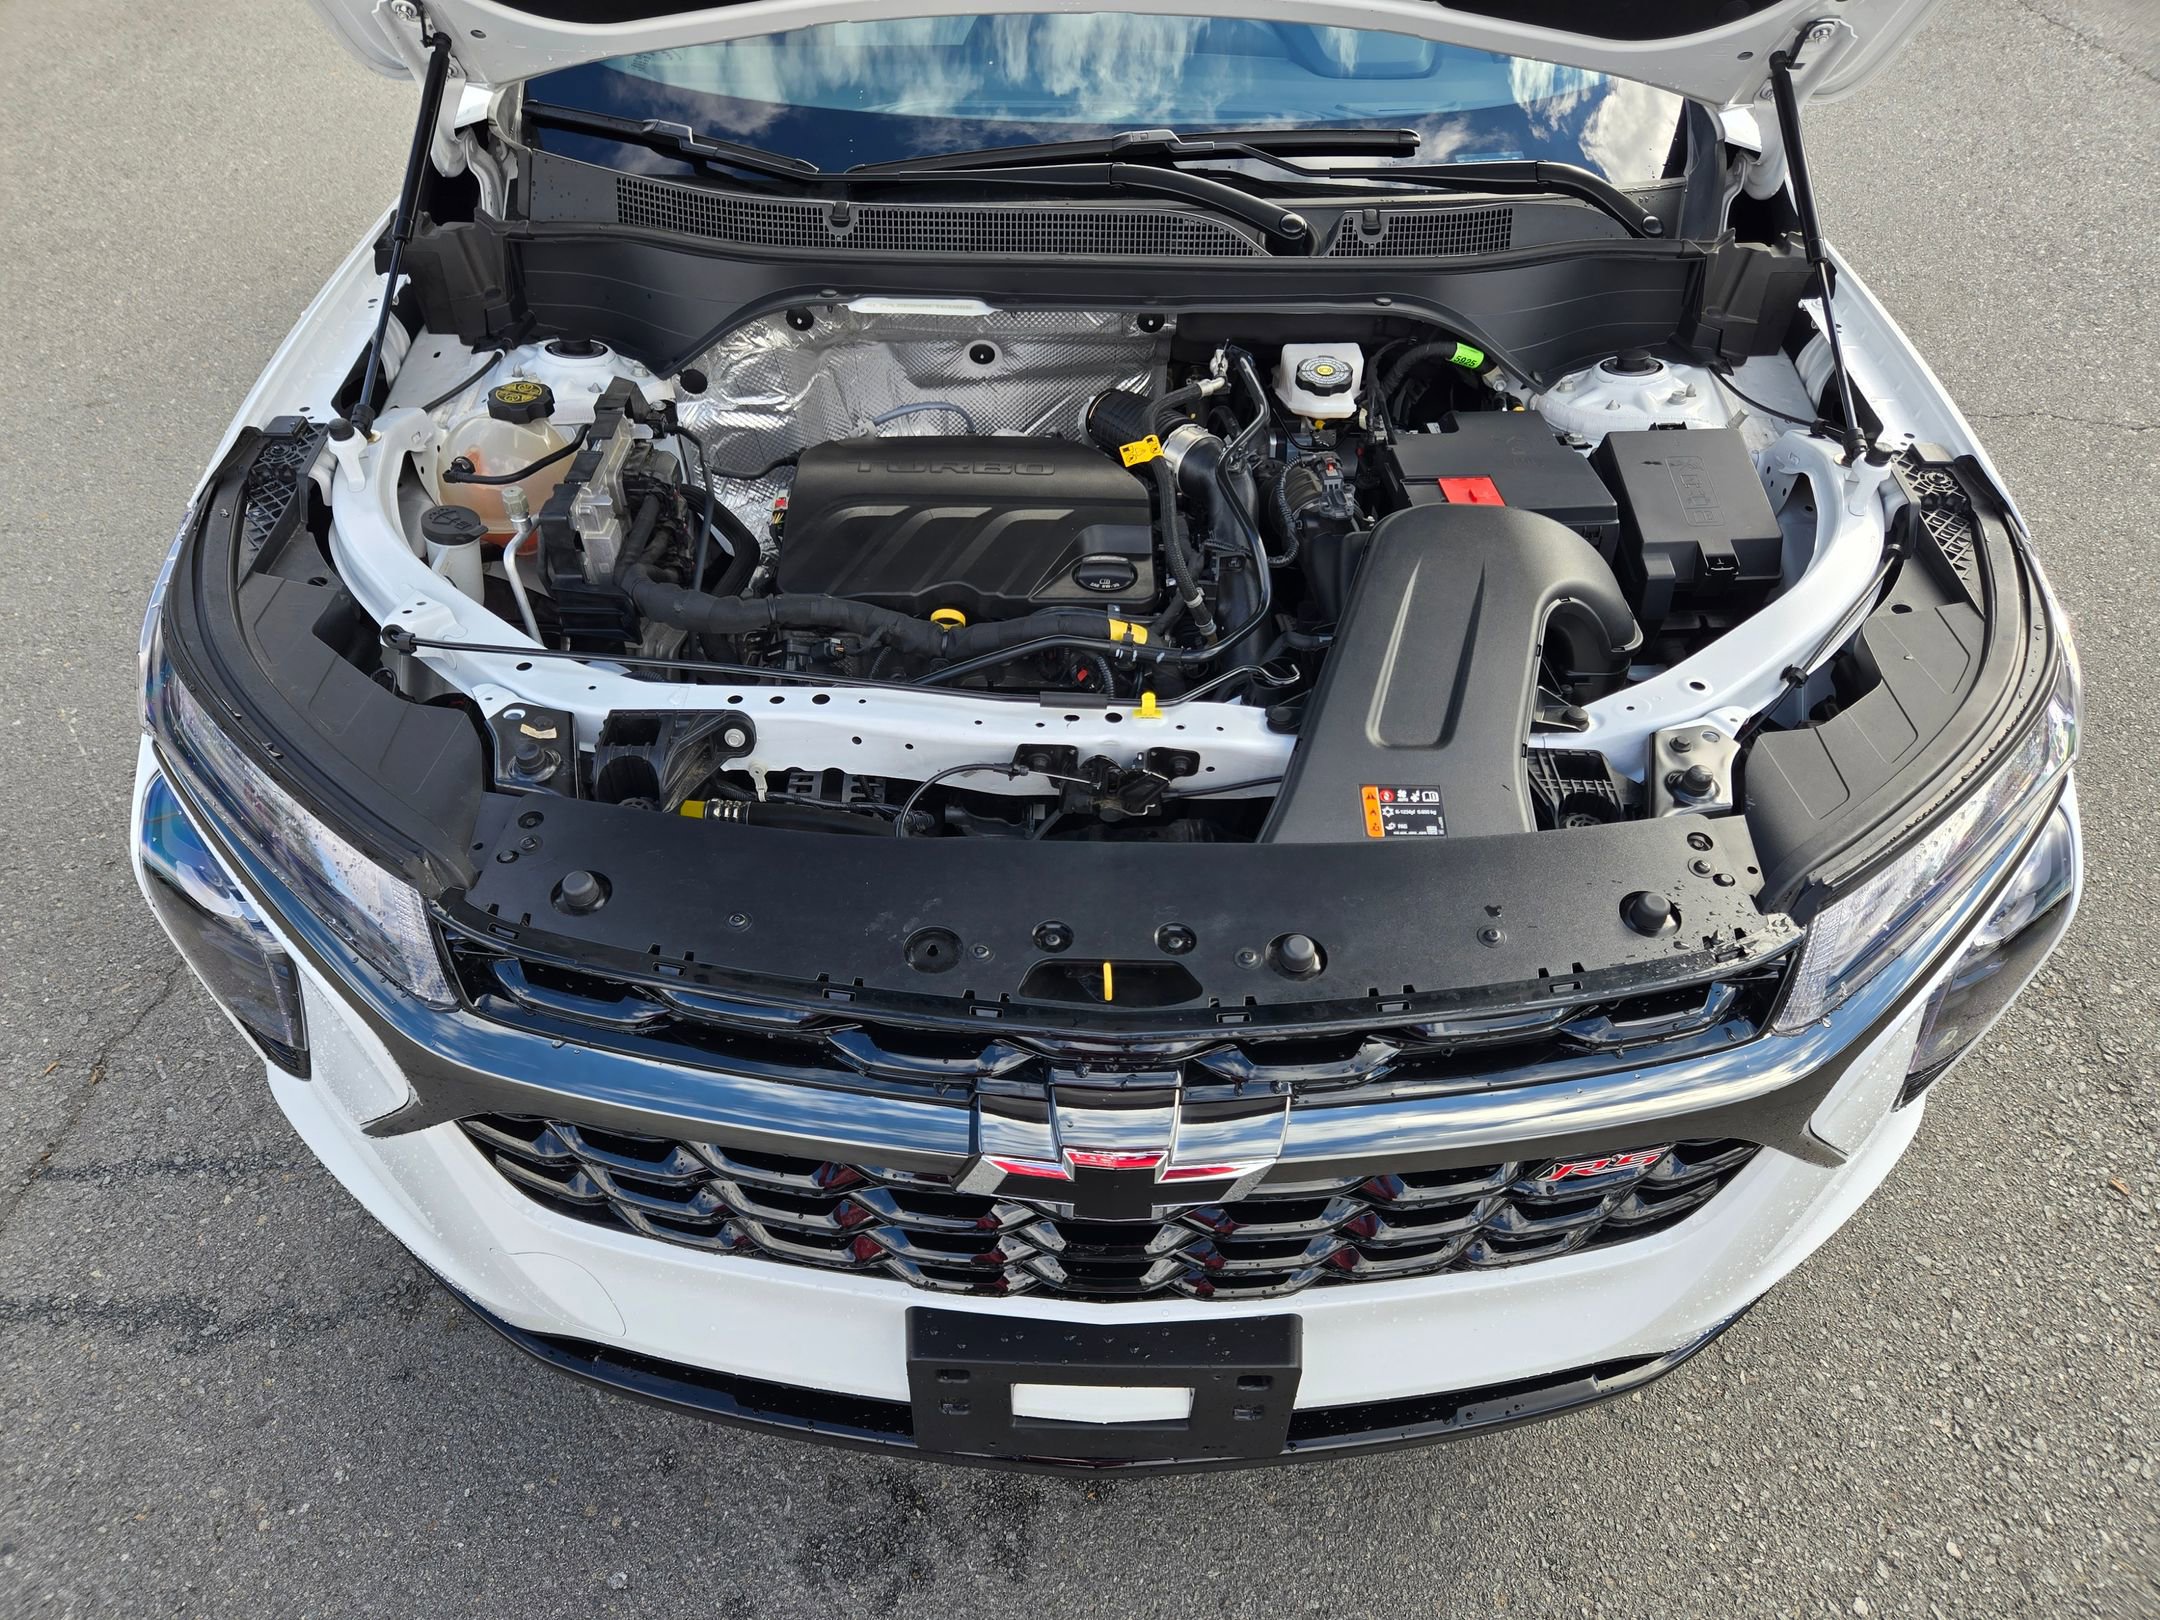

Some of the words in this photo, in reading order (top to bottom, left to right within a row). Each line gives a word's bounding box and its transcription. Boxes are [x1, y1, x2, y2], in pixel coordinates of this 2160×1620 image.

[1454, 355, 1477, 367] 5925
[849, 460, 1055, 476] TURBO
[1535, 1146, 1670, 1182] RS
